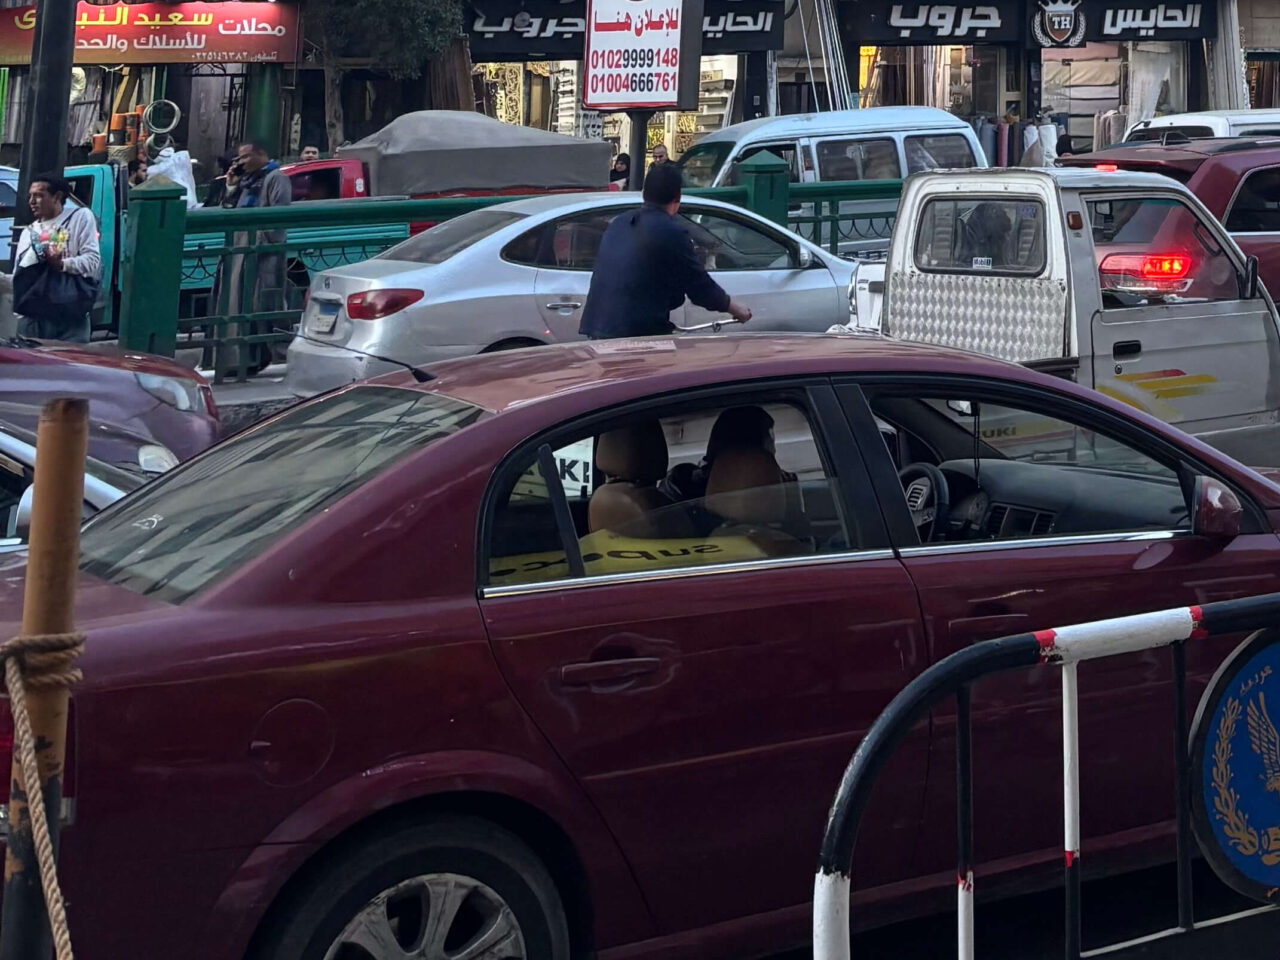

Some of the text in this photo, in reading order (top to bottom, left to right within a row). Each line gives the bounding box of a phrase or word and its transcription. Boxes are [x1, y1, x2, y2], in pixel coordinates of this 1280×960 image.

[133, 11, 213, 30] سعيد
[218, 18, 286, 37] محلات
[593, 6, 680, 37] للإعلان هنا
[890, 4, 1002, 38] جروب
[1051, 16, 1072, 31] TH
[133, 33, 206, 50] للأسلاك
[591, 48, 678, 69] 01029999148
[591, 72, 677, 94] 01004666761
